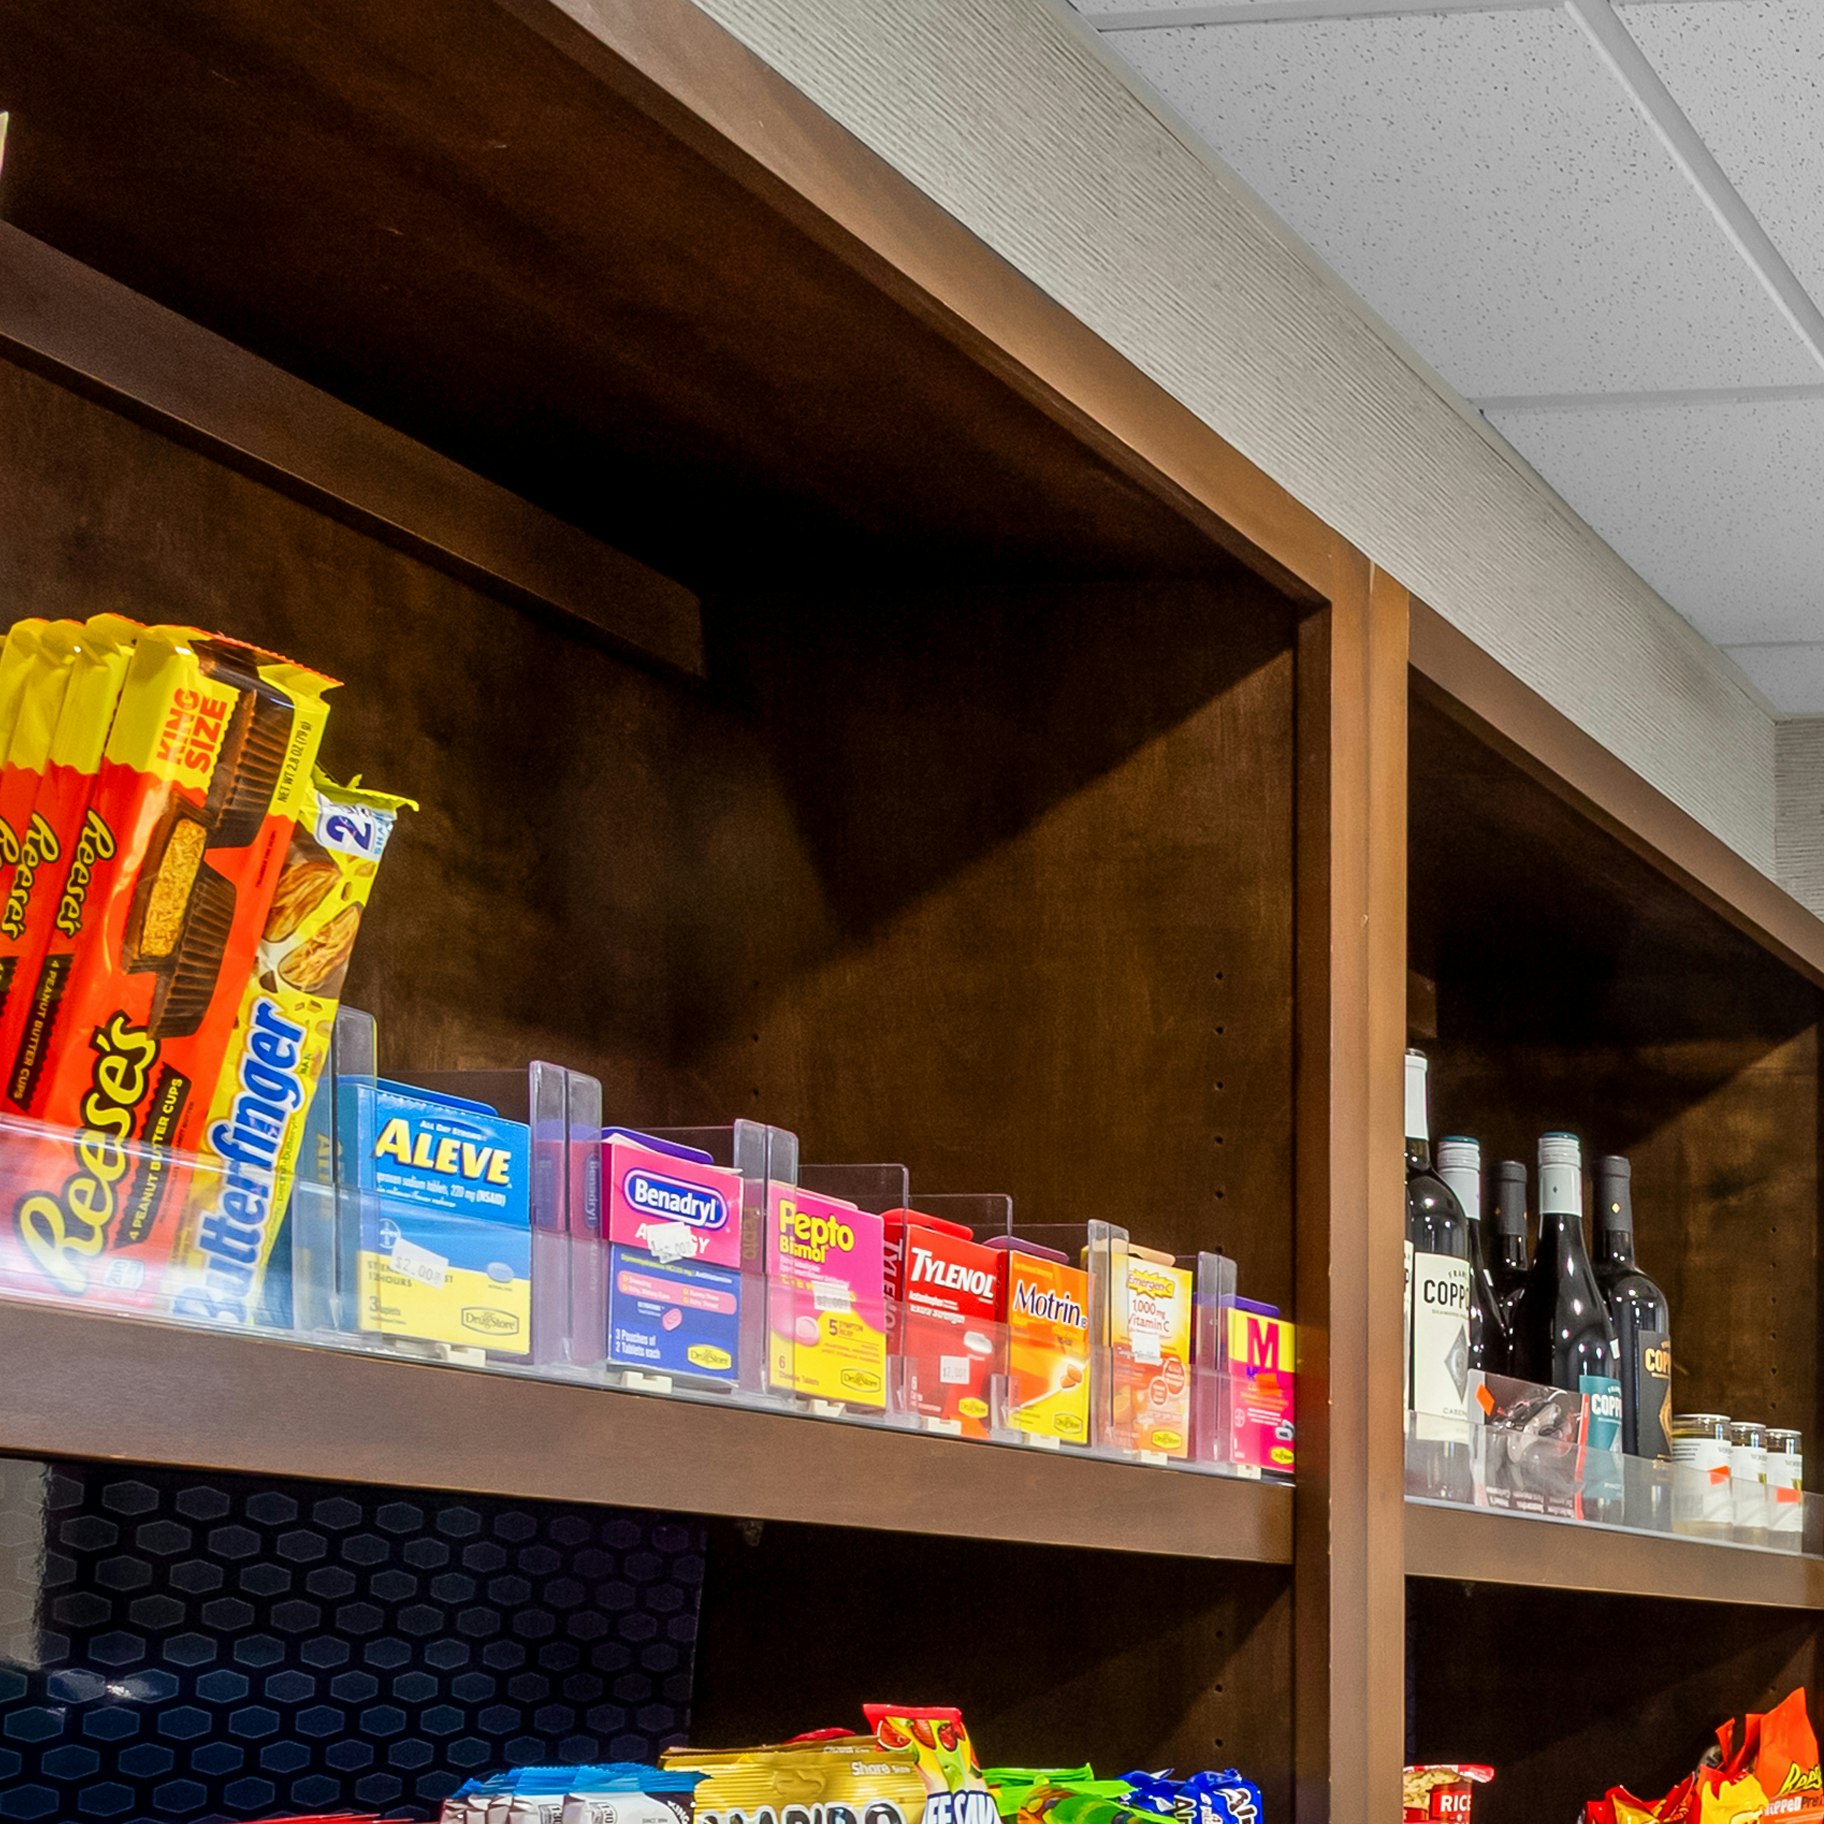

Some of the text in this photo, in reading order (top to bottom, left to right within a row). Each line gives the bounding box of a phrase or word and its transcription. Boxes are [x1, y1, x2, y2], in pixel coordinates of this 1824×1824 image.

[157, 687, 199, 764] KING
[186, 698, 228, 773] SIZE
[278, 786, 290, 802] NET
[284, 772, 294, 784] WT
[291, 743, 303, 757] OZ
[1, 810, 59, 939] Reese's
[56, 808, 115, 938] Reese's
[14, 960, 60, 1099] 4 PEANUT BUTTER CUPS
[162, 1078, 183, 1114] CUPS
[20, 1016, 156, 1294] Reese's
[150, 1116, 170, 1171] BUTTER
[170, 1000, 306, 1324] Butterfinger
[375, 1118, 512, 1185] ALEVE
[132, 1173, 159, 1228] PEANUT
[634, 1177, 717, 1227] Benadryl
[779, 1200, 855, 1252] Pepto
[129, 1231, 140, 1240] 4
[910, 1247, 996, 1298] TYLENOL
[1424, 1280, 1469, 1310] COPP
[829, 1318, 838, 1336] 5
[1013, 1279, 1081, 1326] Motrin
[1163, 1320, 1170, 1332] C
[852, 1762, 890, 1775] Share
[602, 1802, 614, 1824] 130
